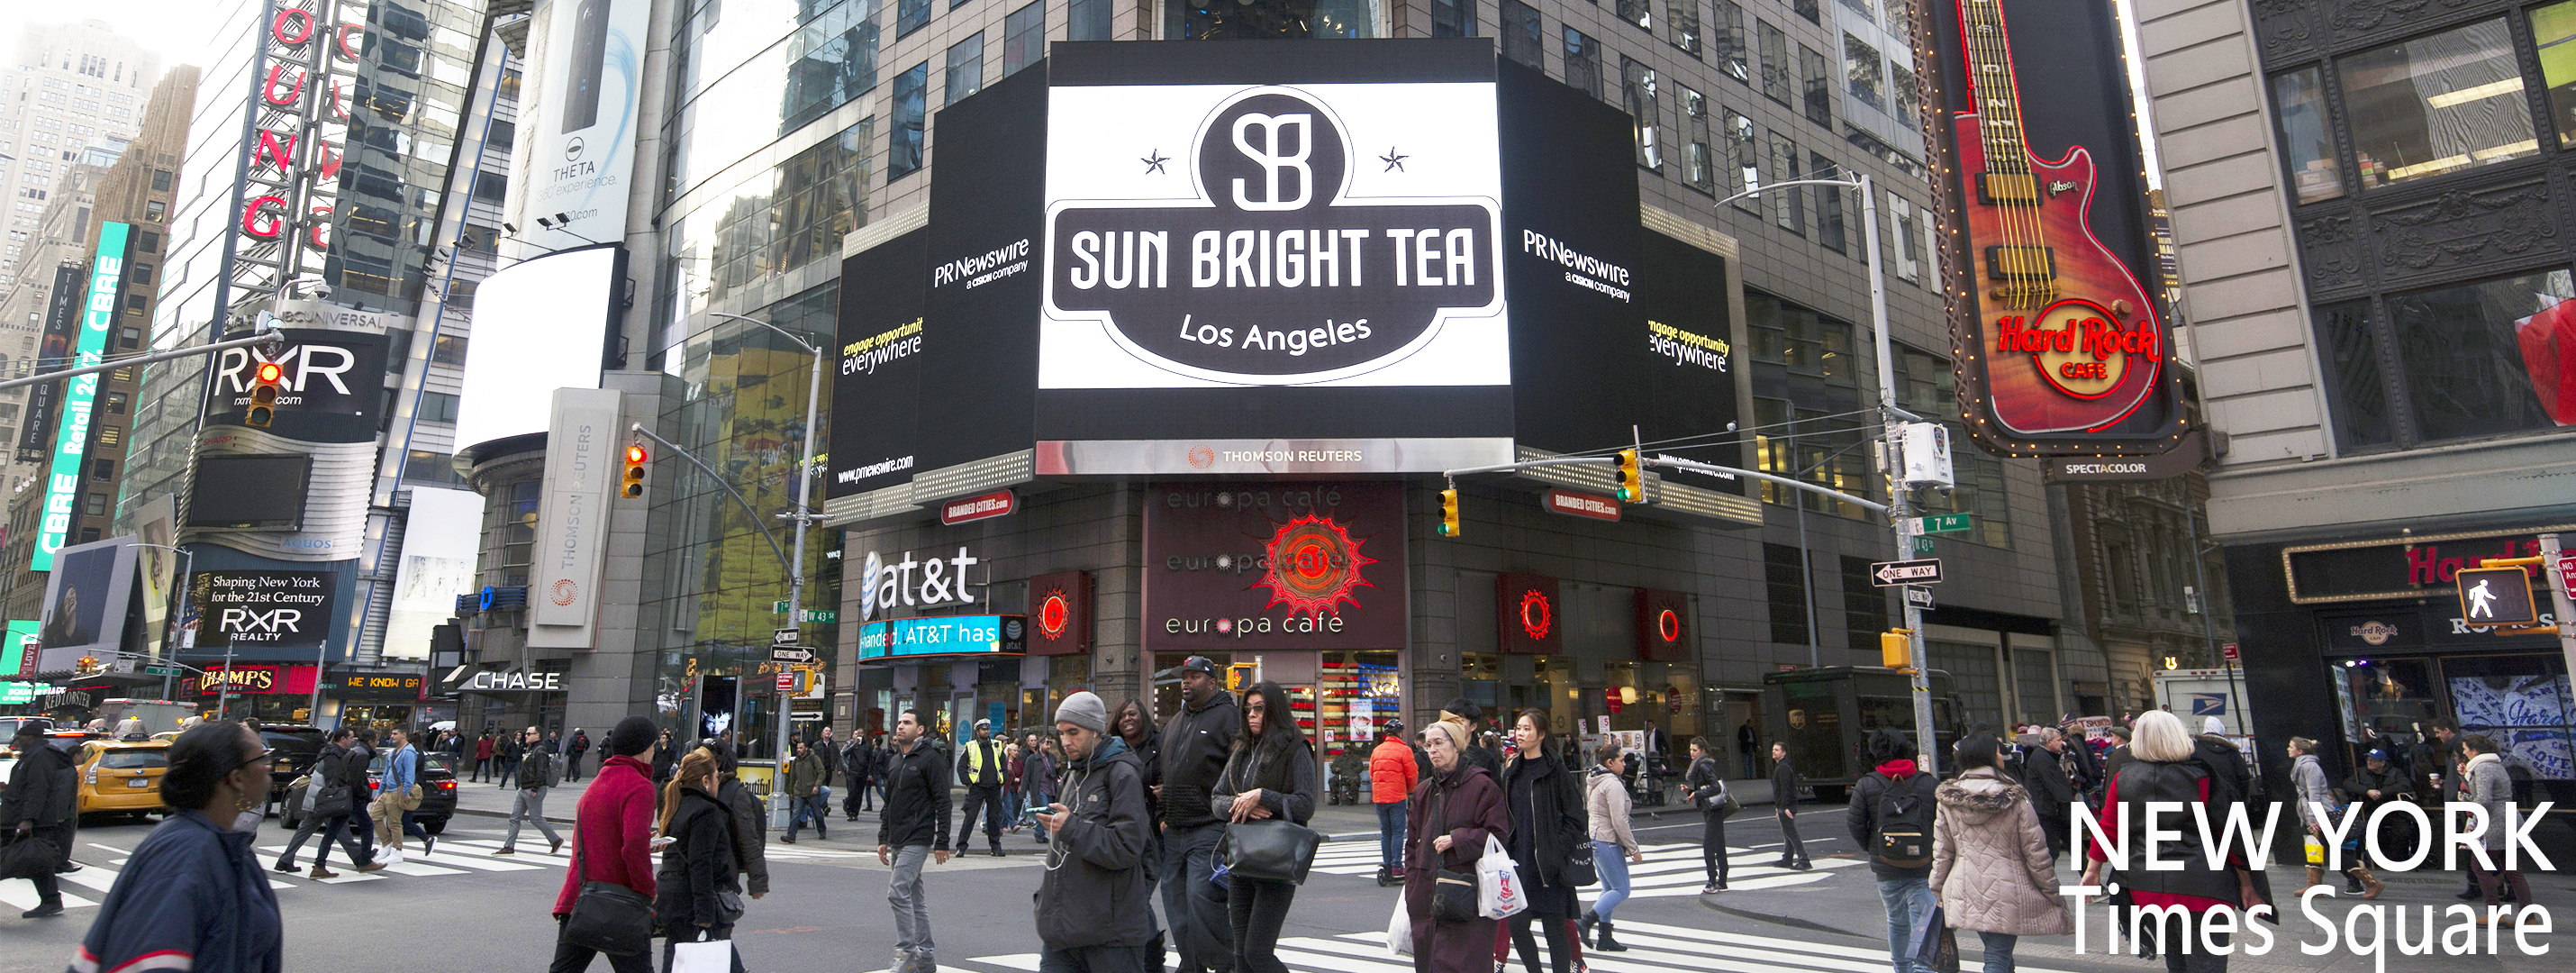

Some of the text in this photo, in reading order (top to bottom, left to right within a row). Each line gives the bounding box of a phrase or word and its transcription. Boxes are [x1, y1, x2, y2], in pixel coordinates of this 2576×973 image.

[553, 160, 594, 182] THETA
[2049, 181, 2079, 195] Gibson
[1070, 227, 1475, 290] SUN BRIGHT TEA
[966, 280, 972, 290] a
[993, 259, 1028, 280] company
[88, 255, 123, 332] CBRE
[1565, 271, 1572, 282] a
[1594, 280, 1630, 304] company
[1179, 314, 1372, 356] Los Angeles
[1647, 320, 1729, 358] ngage opportunity
[1997, 316, 2158, 362] Hard Rock
[842, 335, 921, 376] everywhere
[843, 335, 874, 358] engage
[31, 273, 72, 443] TIMES QUARE
[214, 344, 355, 396] RXR
[2061, 362, 2108, 379] CAFE
[63, 400, 93, 455] Retail
[203, 435, 232, 446] SHARP
[1223, 450, 1363, 462] THOMSON REUTERS
[2066, 463, 2146, 475] SPECTACOLOR
[561, 424, 591, 569] THOMSON REUTERS
[1282, 486, 1341, 506] café
[1556, 494, 1616, 514] BRANDED CITIES.com
[41, 473, 79, 555] CBRE
[948, 498, 1008, 518] BRANDED CITIES.com
[1935, 517, 1956, 531] 7 Av
[283, 538, 331, 550] AQUOS
[1922, 540, 1927, 551] 43
[1283, 548, 1342, 568] café
[2562, 562, 2573, 571] NO
[213, 575, 321, 590] Shaping New York
[878, 546, 977, 609] at&t
[1882, 567, 1931, 578] ONE WAY
[212, 591, 325, 606] for the 21st Century
[220, 608, 302, 632] RXR
[809, 613, 815, 621] W
[818, 613, 826, 621] 43
[1283, 612, 1343, 632] café
[905, 625, 952, 643] AT&T
[958, 623, 996, 641] has
[2351, 624, 2398, 636] Hard Rock
[24, 644, 36, 667] LOVE
[1006, 641, 1021, 650] at&t
[201, 670, 272, 690] CHAMPS
[348, 677, 419, 687] WE KNOW GA
[474, 672, 560, 689] CHASE
[44, 695, 59, 711] RED
[61, 690, 90, 708] LOBSTER
[1791, 715, 1804, 726] ups
